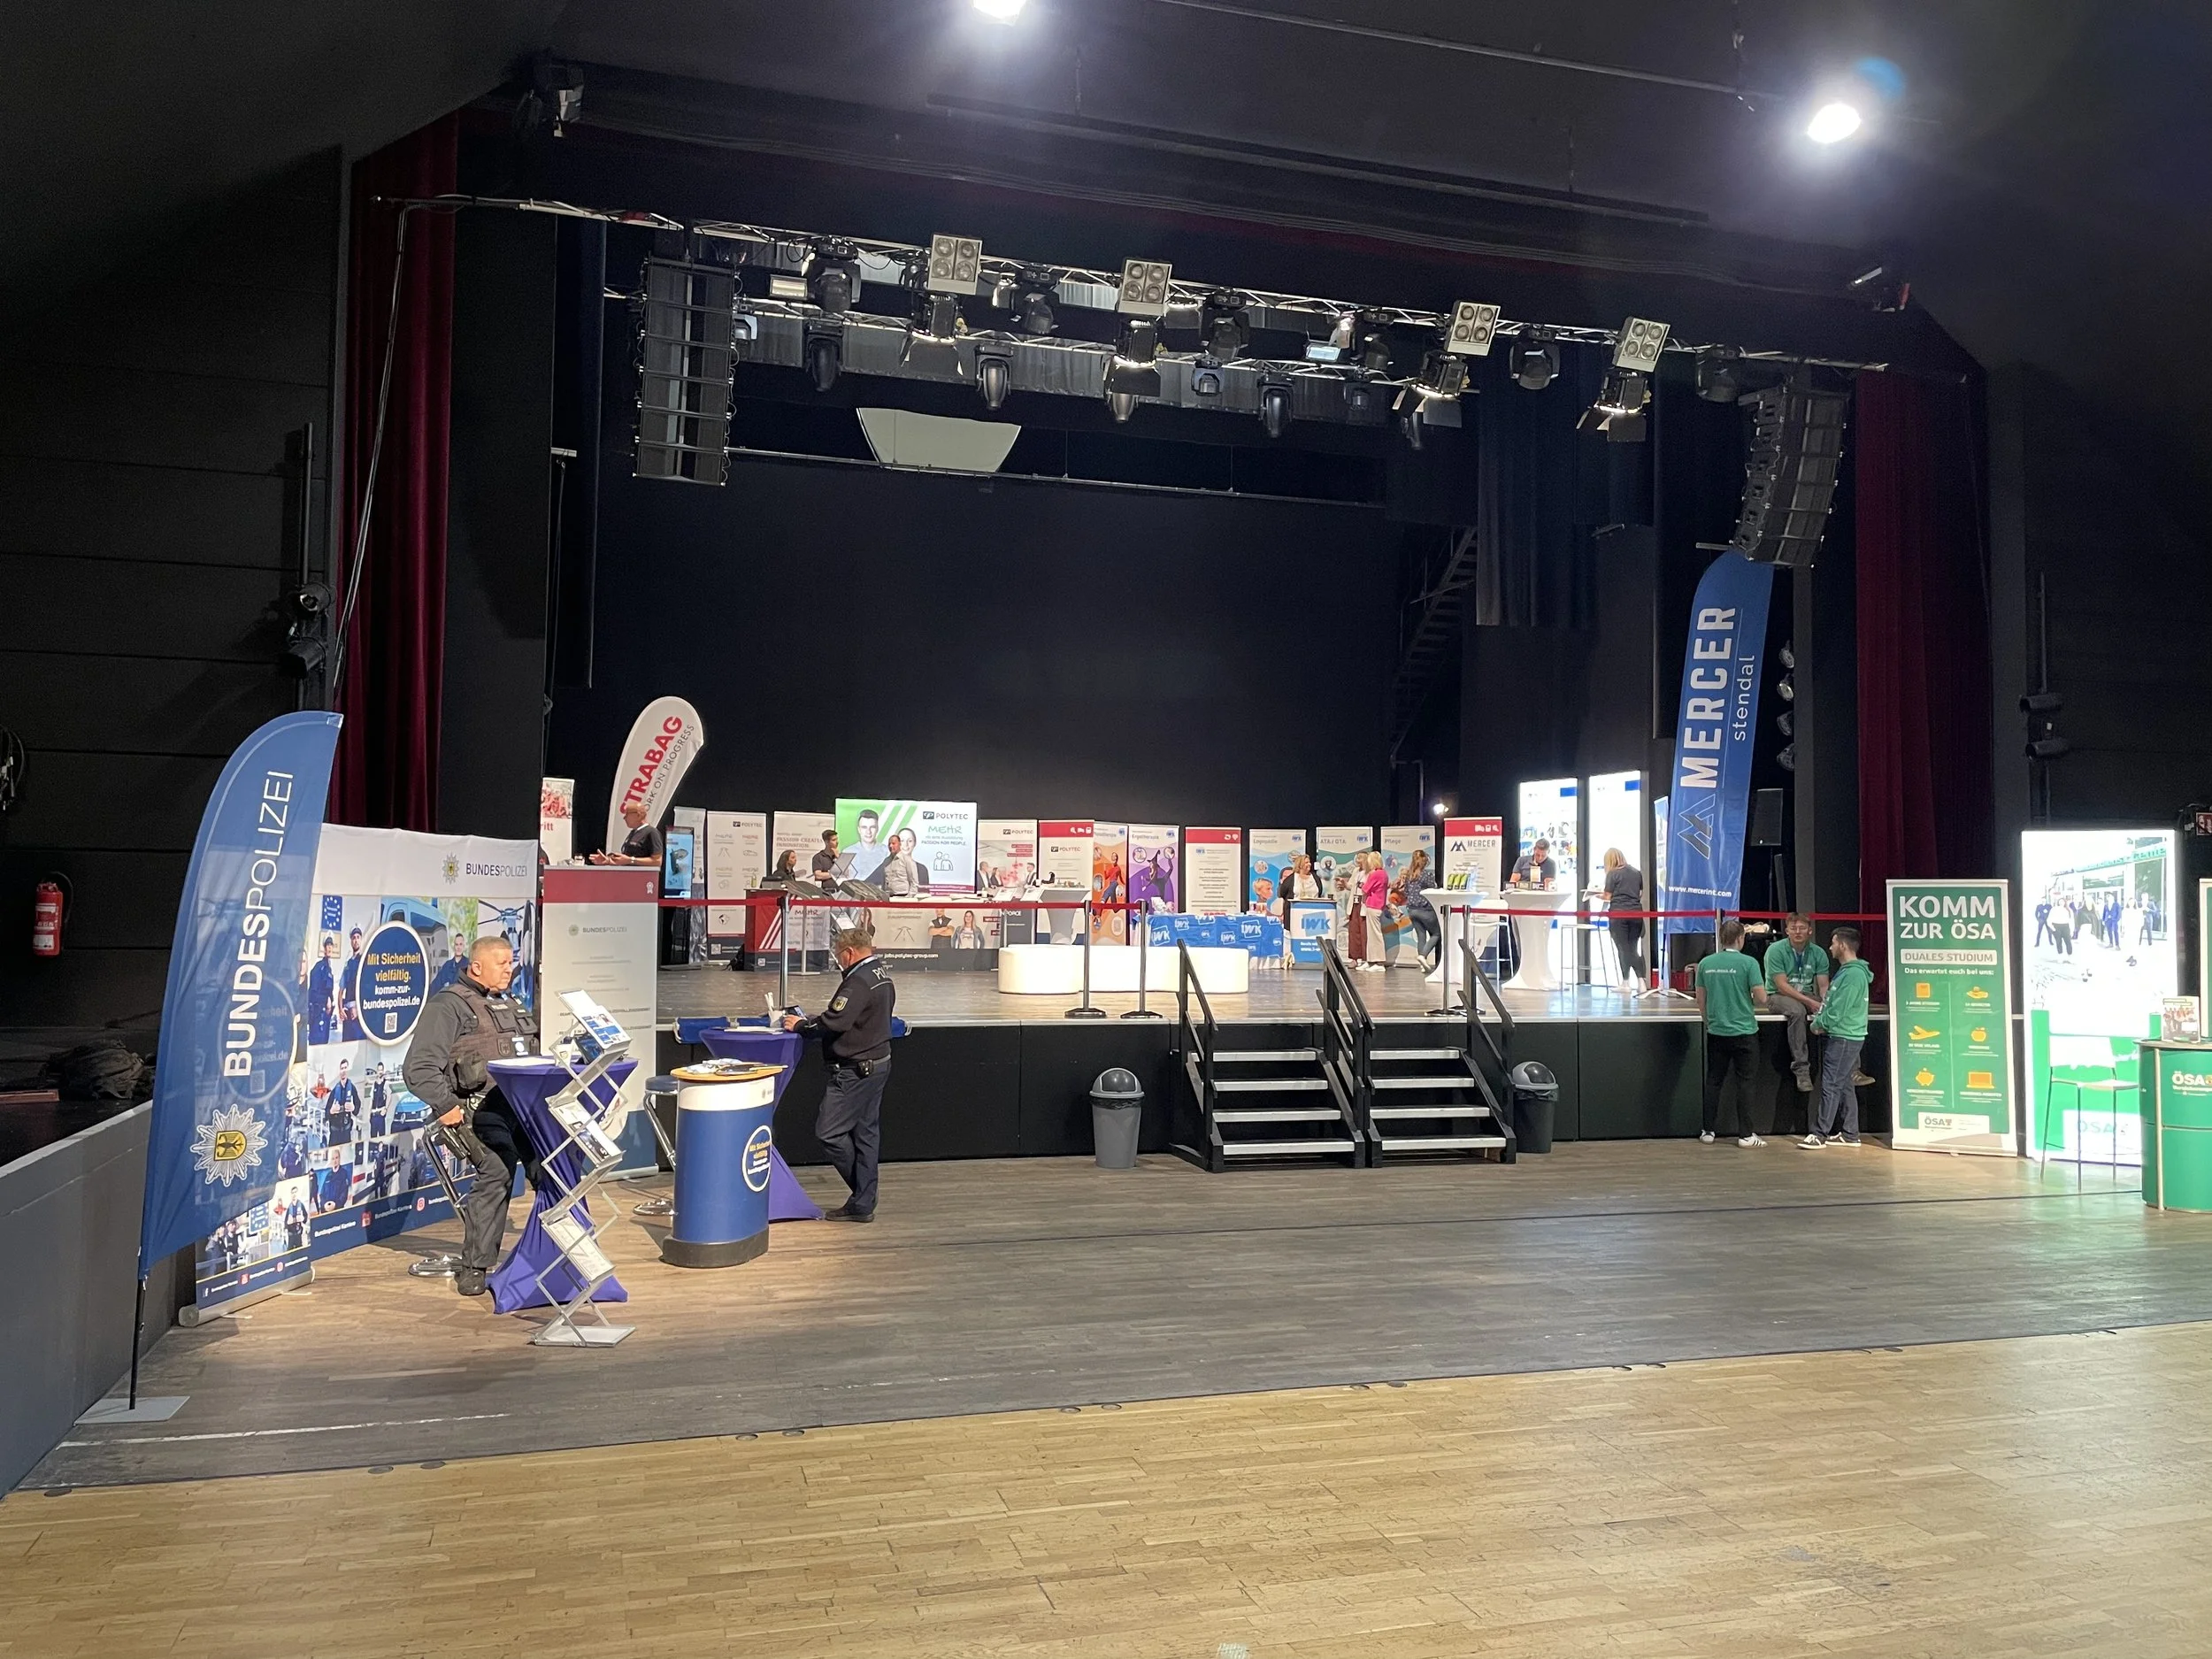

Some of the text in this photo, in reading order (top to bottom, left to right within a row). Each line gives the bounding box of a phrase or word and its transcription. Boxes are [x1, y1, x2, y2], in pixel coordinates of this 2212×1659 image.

[1680, 608, 1736, 788] MERCER
[1732, 655, 1755, 741] stendal
[655, 773, 665, 788] ON
[664, 725, 695, 771] PROGRESS
[927, 826, 963, 834] MEHR
[1468, 839, 1496, 848] MERCER
[465, 863, 527, 877] BUNDESPOLIZEI
[1899, 895, 1996, 918] KOMM
[223, 771, 294, 1077] BUNDESPOLIZEI
[1240, 924, 1262, 934] IWK
[1301, 918, 1331, 930] IWK
[1900, 919, 1996, 940] ZUR ÖSA
[1151, 930, 1171, 942] IWK
[367, 952, 421, 965] Mit Sicherheit
[1904, 952, 1993, 962] DUALES STUDIUM
[375, 970, 411, 983] vielfältig.
[375, 984, 411, 995] komm-zur-
[363, 995, 420, 1010] bundespolizei.de
[2172, 1071, 2206, 1086] ÖSA
[1924, 1117, 1945, 1125] ÖSA
